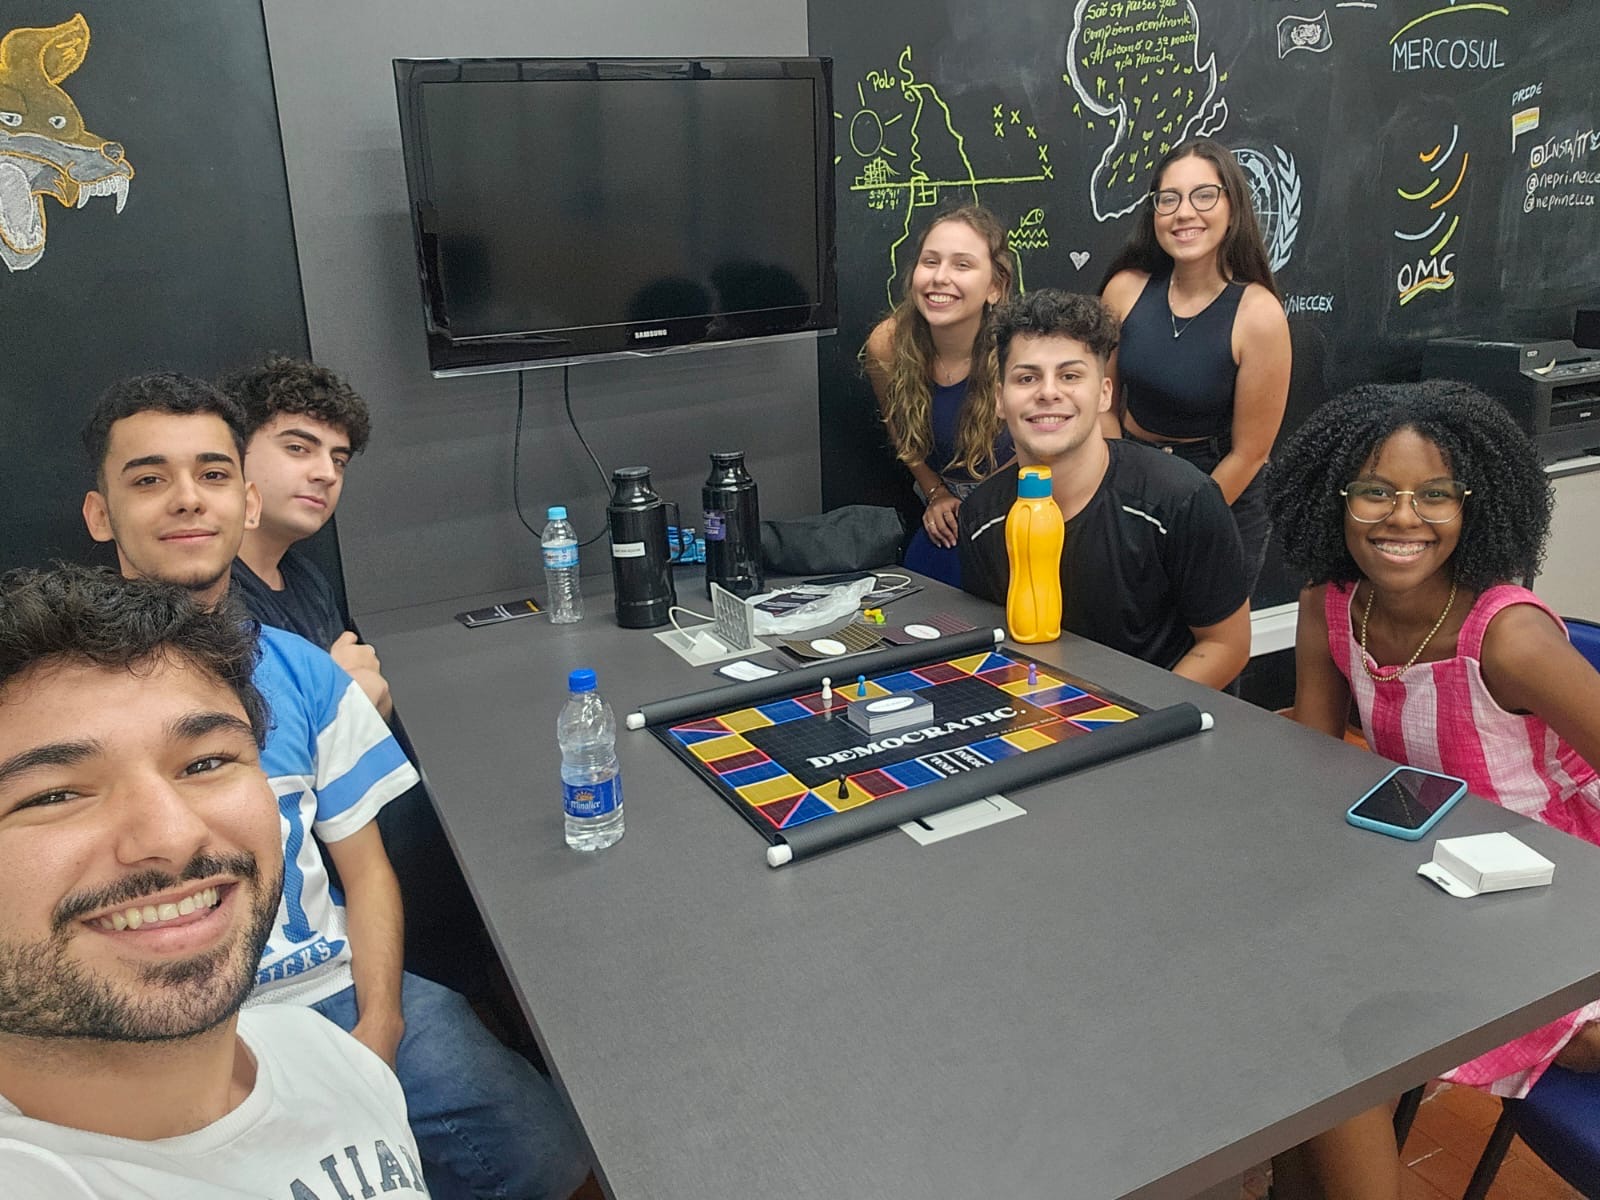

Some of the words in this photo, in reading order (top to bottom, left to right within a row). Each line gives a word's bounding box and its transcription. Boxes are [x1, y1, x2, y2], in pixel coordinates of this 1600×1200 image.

[1392, 37, 1505, 72] MERCOSUL
[1511, 82, 1544, 106] PRIDE
[1397, 253, 1456, 292] OMC
[634, 328, 668, 339] SAMSUNG
